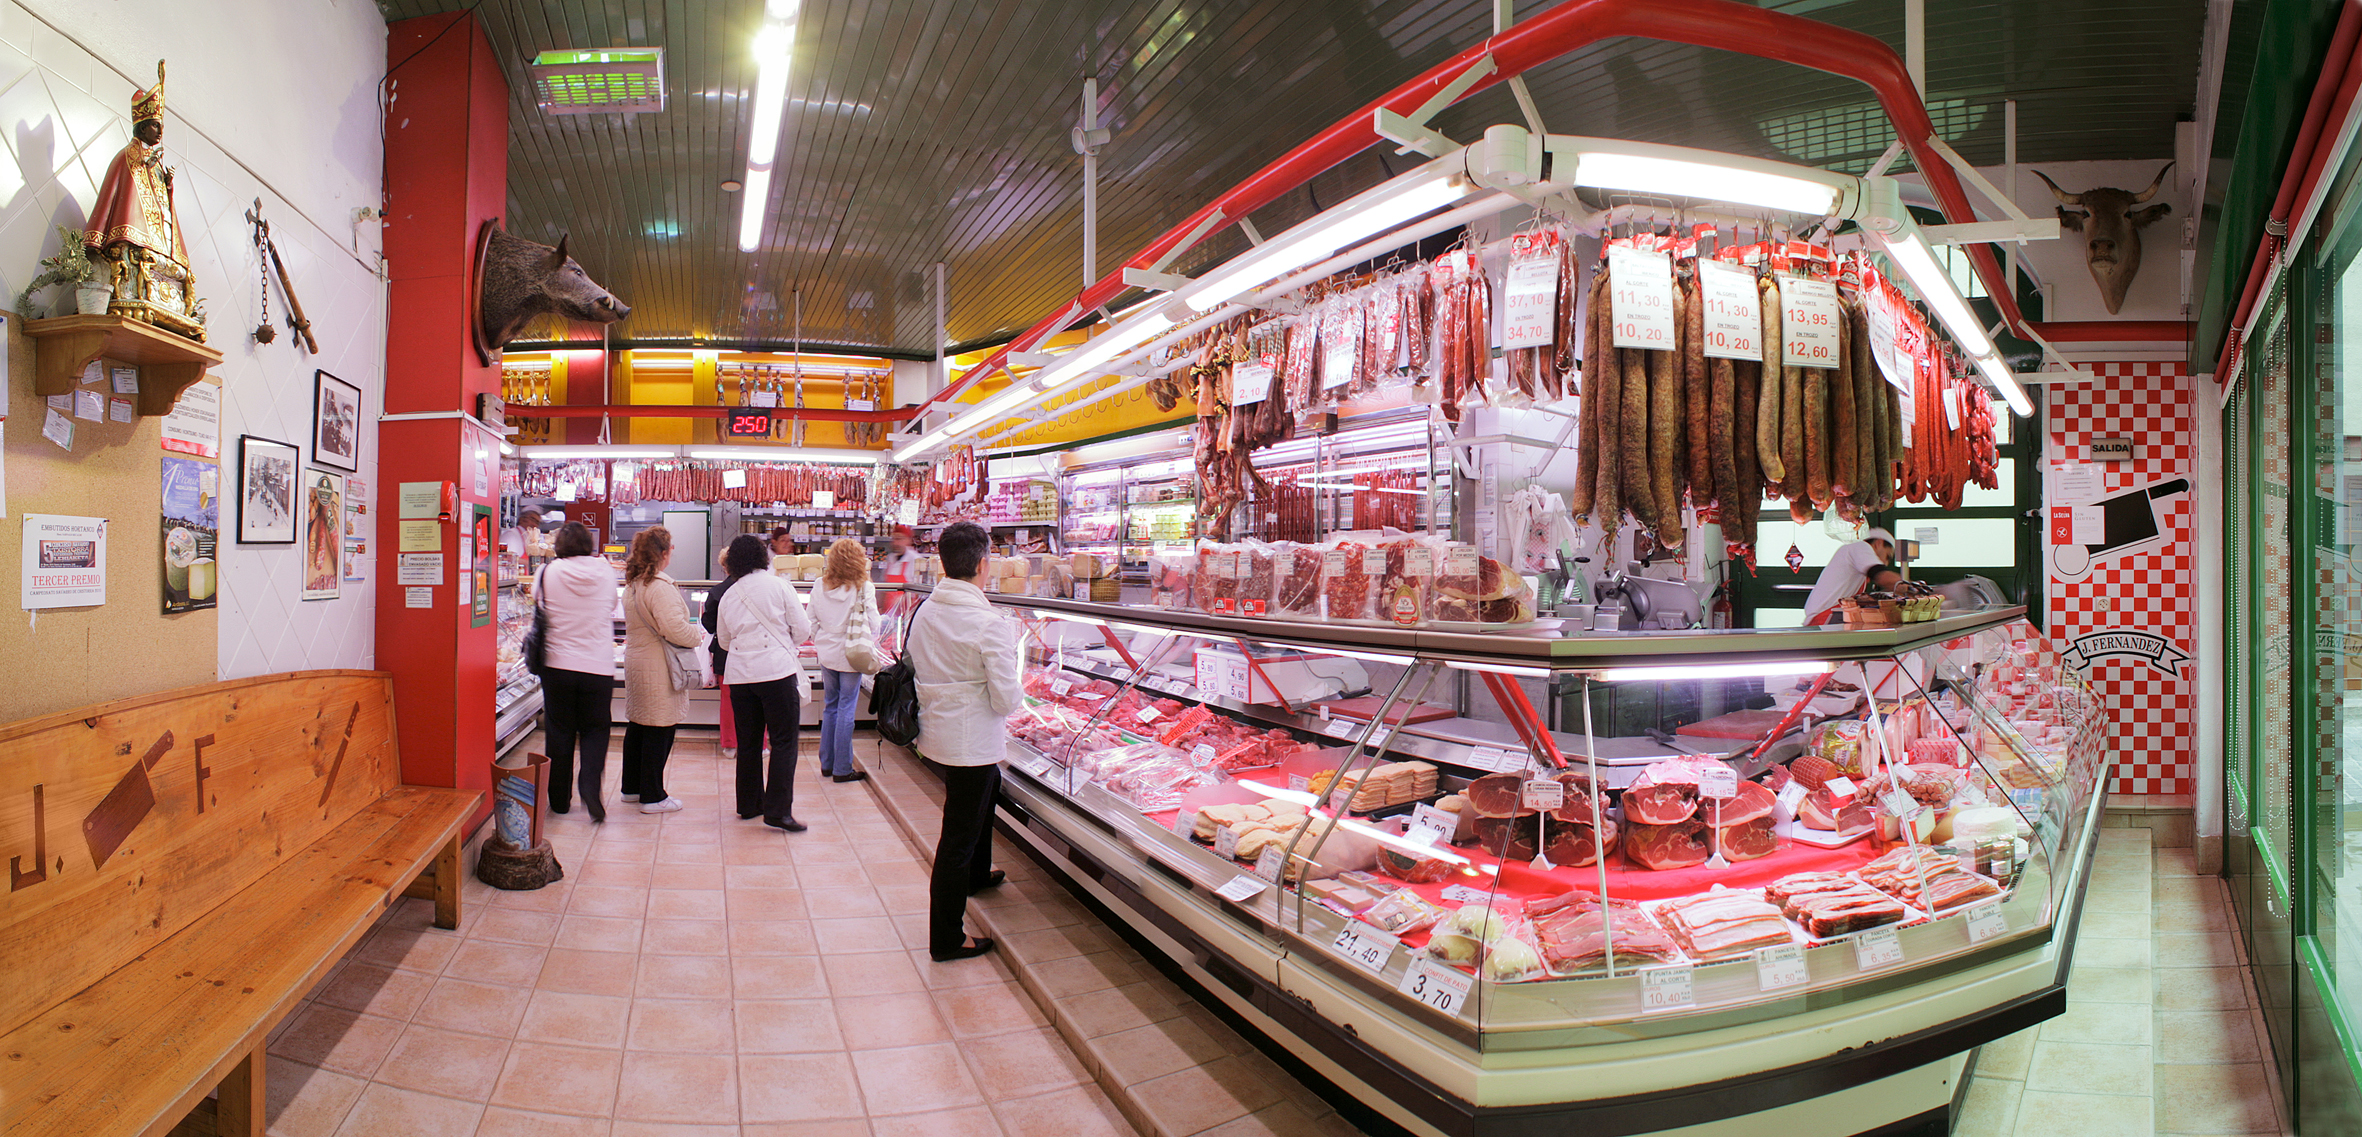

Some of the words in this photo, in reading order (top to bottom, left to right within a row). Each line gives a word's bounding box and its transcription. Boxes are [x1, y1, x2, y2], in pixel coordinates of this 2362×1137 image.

[733, 416, 768, 433] 250
[2092, 444, 2129, 452] SALIDA
[41, 524, 70, 532] EMBUTIDOS
[32, 576, 68, 586] TERCER
[72, 574, 100, 585] PREMIO
[2082, 642, 2091, 654] J.
[2092, 636, 2161, 654] FERNANDEZ
[1425, 967, 1444, 980] CONFIT
[1444, 976, 1452, 984] DE
[1452, 979, 1468, 991] PATO
